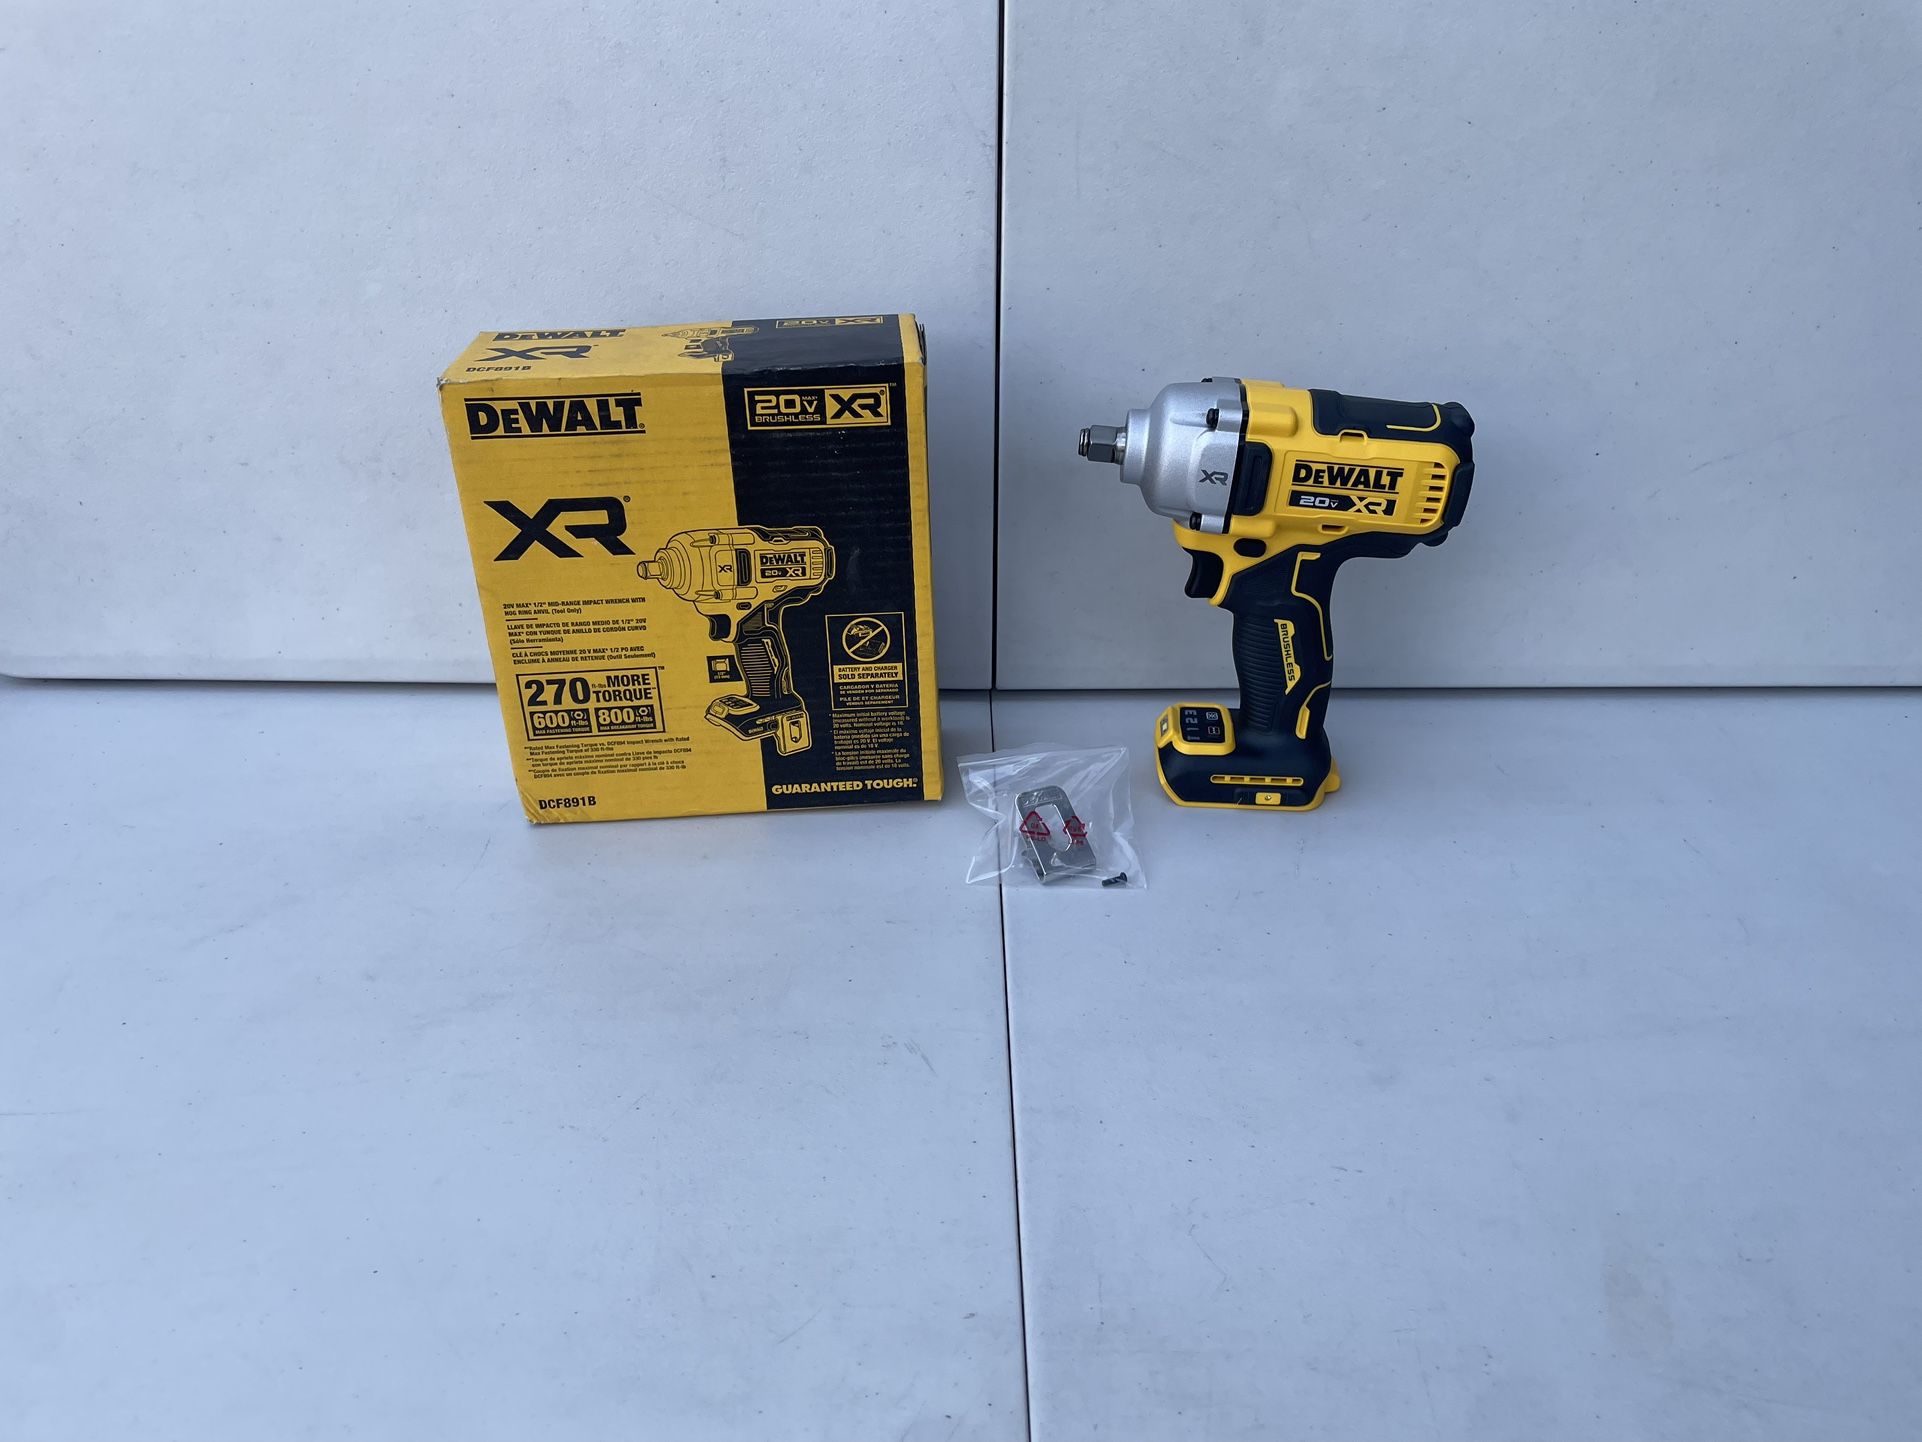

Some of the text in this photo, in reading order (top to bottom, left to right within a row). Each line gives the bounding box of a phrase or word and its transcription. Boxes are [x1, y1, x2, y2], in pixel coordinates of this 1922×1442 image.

[475, 345, 593, 361] XR
[828, 392, 884, 420] XR
[755, 414, 820, 423] BRUSHLESS
[1199, 468, 1228, 486] XR
[1348, 495, 1387, 515] XR
[483, 496, 636, 561] XR
[718, 565, 733, 573] XR
[786, 568, 802, 577] XR
[1280, 623, 1295, 682] BRUSHLESS
[524, 677, 591, 707] 270
[605, 673, 651, 688] MORE
[533, 711, 570, 728] 600
[598, 708, 634, 725] 800
[771, 778, 917, 795] GUARANTEED TOUGH.
[538, 796, 596, 810] DCF891B
